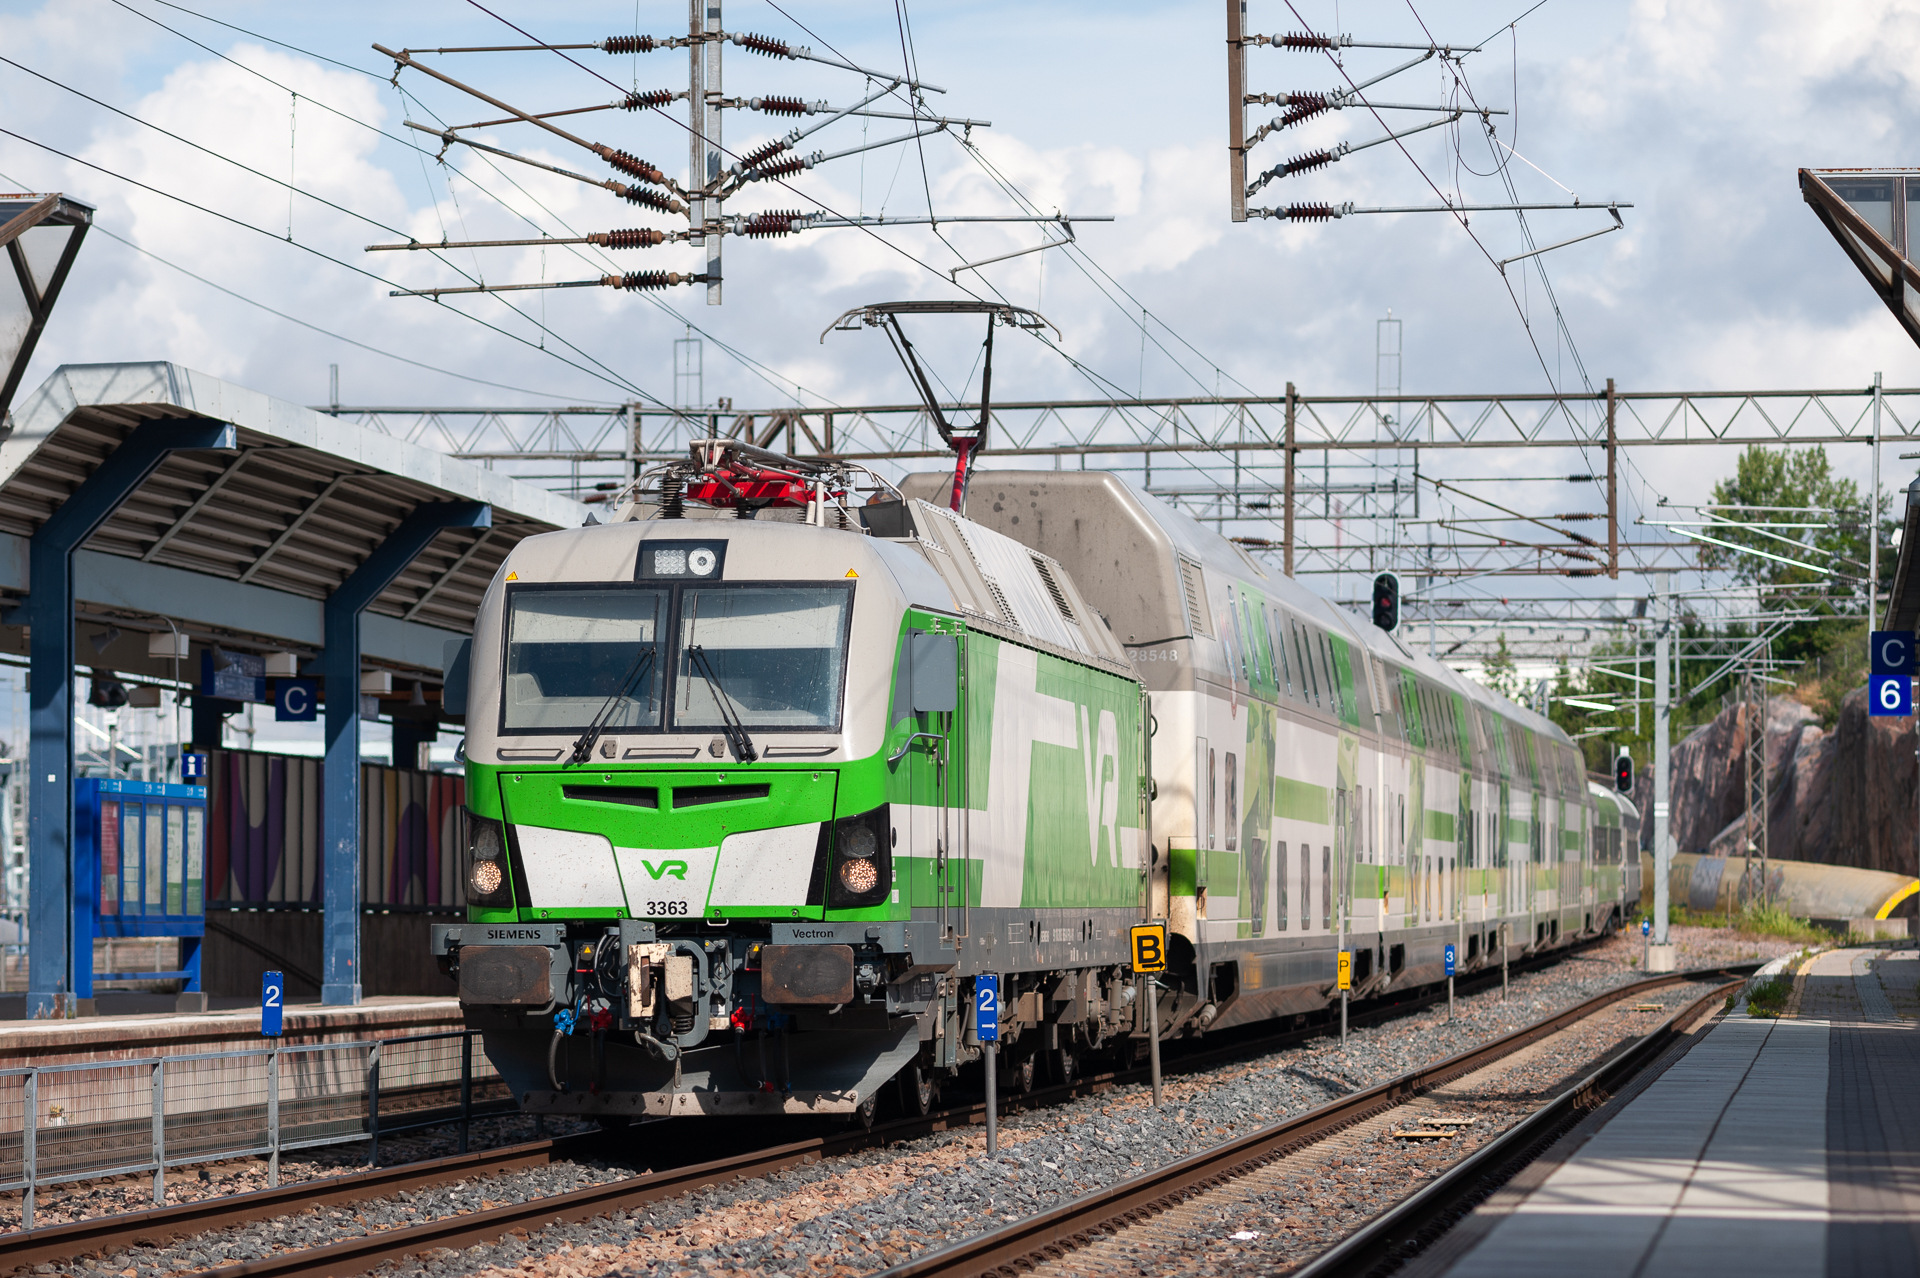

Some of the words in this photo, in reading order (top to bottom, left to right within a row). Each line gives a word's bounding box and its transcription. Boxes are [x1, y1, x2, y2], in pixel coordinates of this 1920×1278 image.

[1882, 639, 1905, 667] C
[284, 686, 308, 714] C
[1880, 679, 1901, 710] 6
[1081, 704, 1119, 868] VR
[641, 860, 688, 881] VR
[646, 901, 688, 916] 3363
[487, 929, 541, 940] SIEMENS
[792, 929, 834, 938] Vectron
[1136, 934, 1162, 965] B
[1445, 951, 1454, 963] 3
[1339, 960, 1349, 972] P
[265, 985, 280, 1007] 2
[979, 988, 995, 1011] 2
